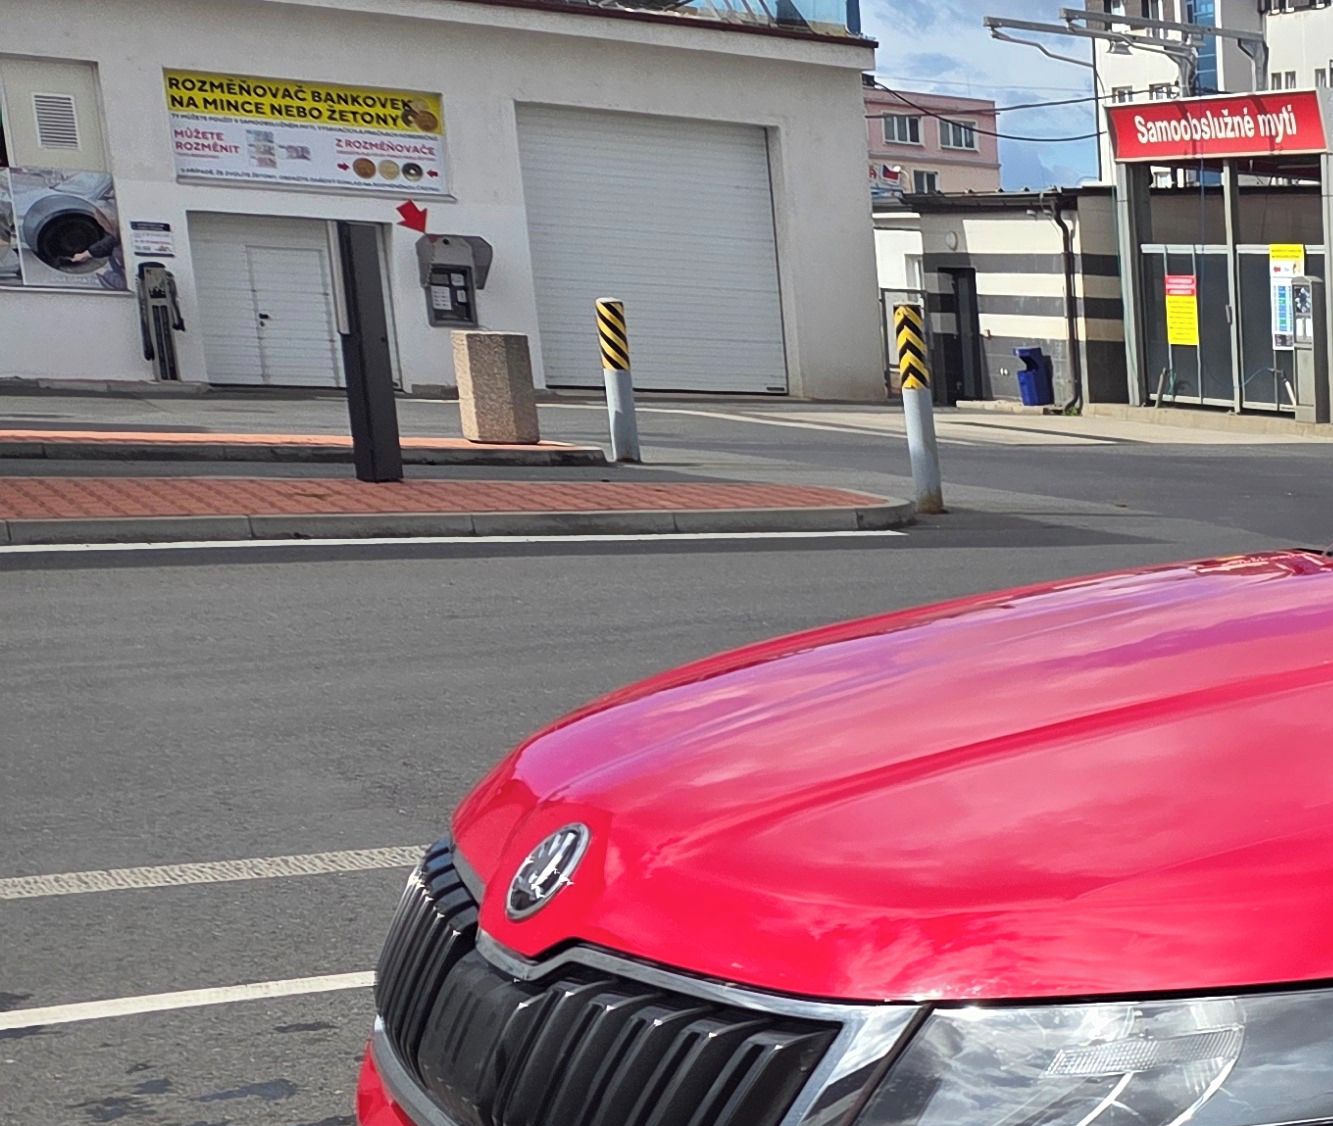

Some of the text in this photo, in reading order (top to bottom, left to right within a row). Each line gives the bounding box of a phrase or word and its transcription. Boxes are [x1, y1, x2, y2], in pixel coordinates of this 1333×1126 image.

[168, 77, 414, 113] ROZMĚŇOVAČ BANKOVEK
[170, 95, 400, 127] NA MINCE NEBO ŽETONY
[174, 127, 225, 142] MŮŽETE
[1134, 104, 1297, 144] Samoobslužné mytí
[175, 140, 240, 154] ROZMĚNIT
[335, 138, 343, 148] Z
[345, 139, 437, 156] ROZMĚŇOVAČE
